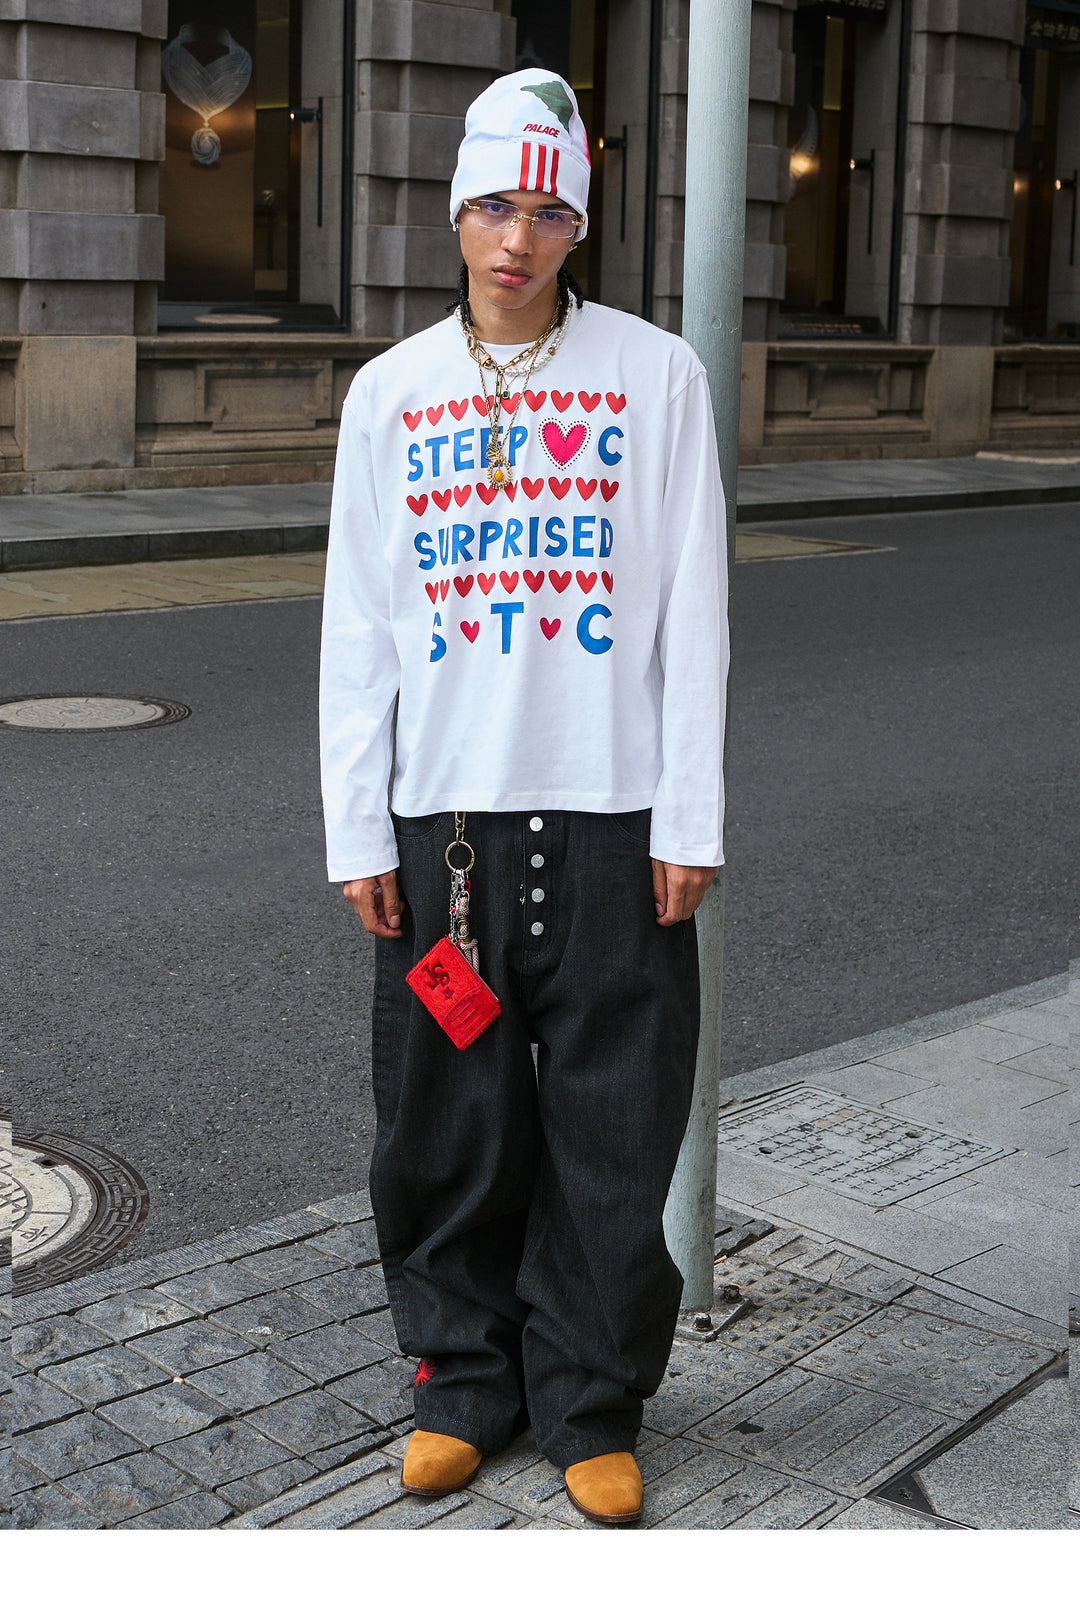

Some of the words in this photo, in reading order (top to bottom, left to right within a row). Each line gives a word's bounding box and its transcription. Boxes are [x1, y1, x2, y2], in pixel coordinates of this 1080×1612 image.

[523, 123, 560, 138] PALACE
[407, 425, 529, 482] STEEP
[598, 425, 625, 466] C
[414, 515, 614, 570] SURPRISED
[429, 612, 447, 663] S
[490, 601, 525, 654] T
[576, 603, 614, 655] C
